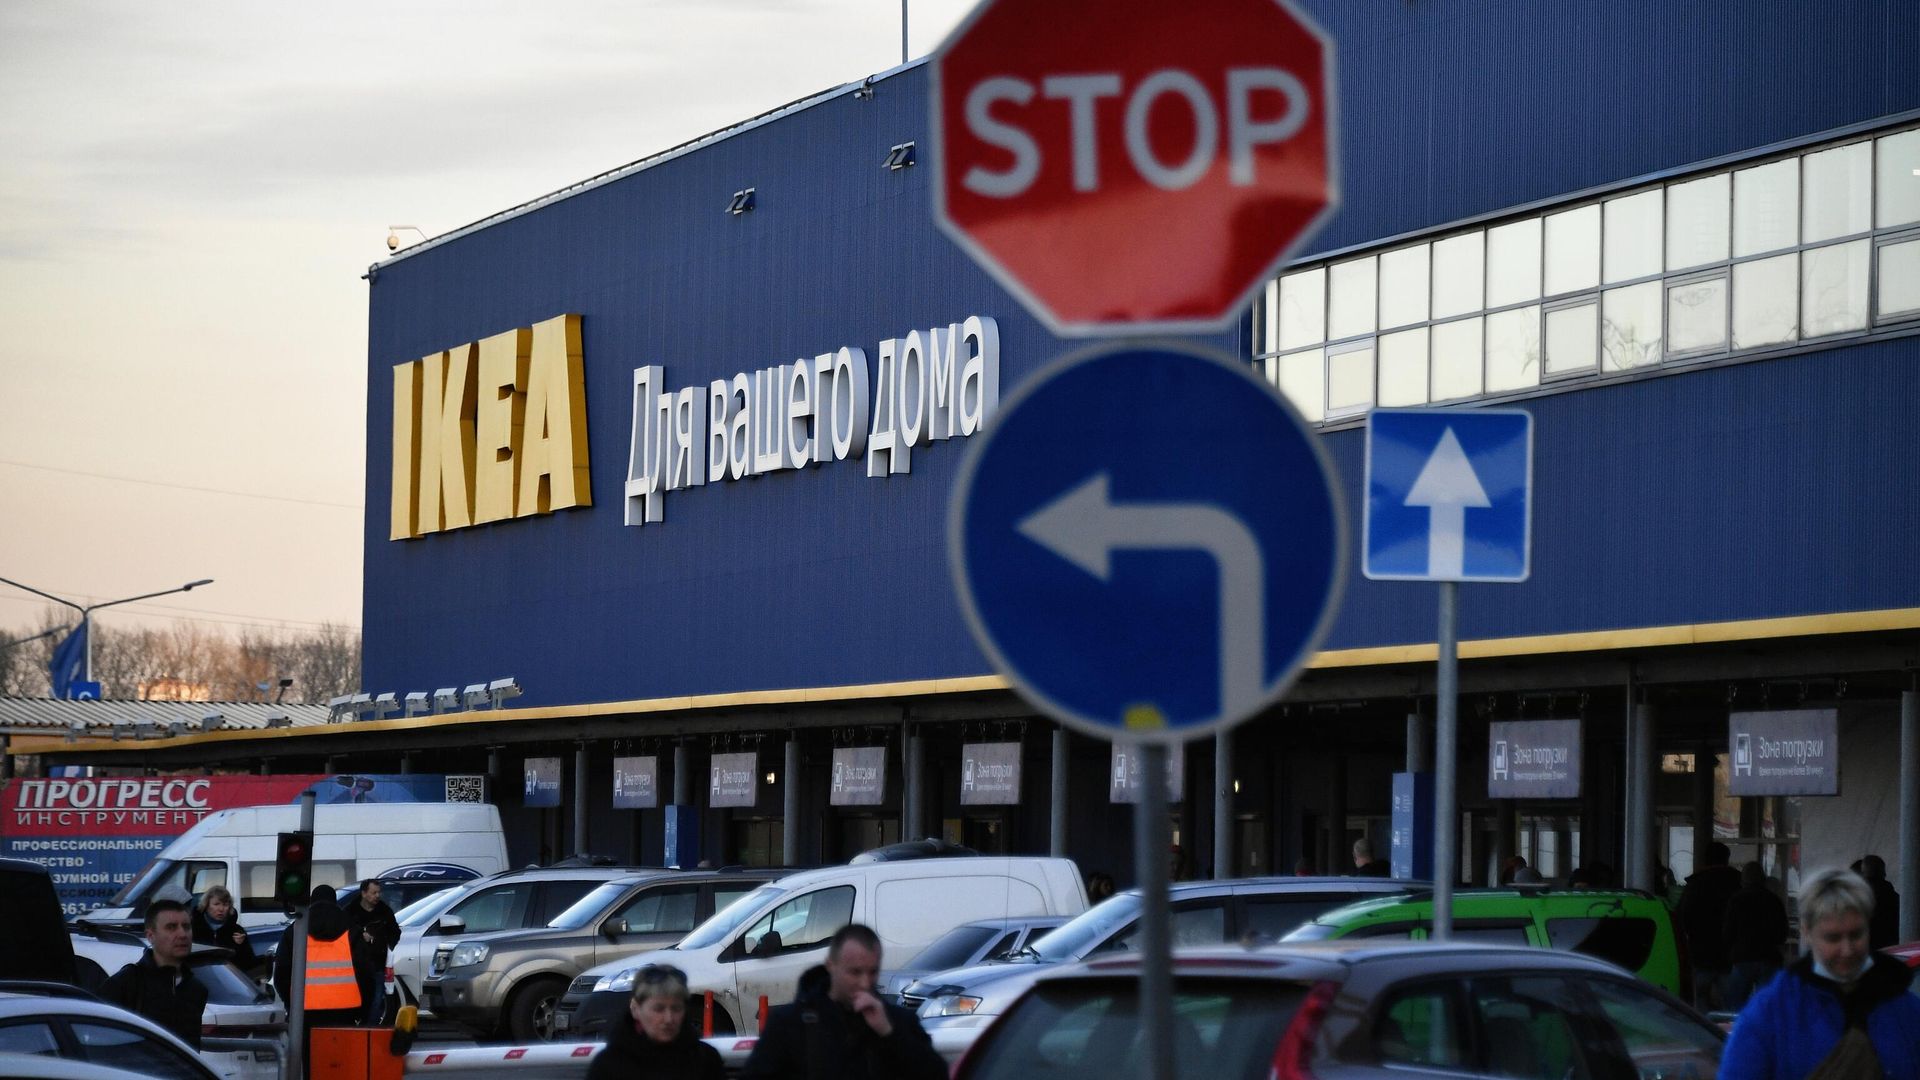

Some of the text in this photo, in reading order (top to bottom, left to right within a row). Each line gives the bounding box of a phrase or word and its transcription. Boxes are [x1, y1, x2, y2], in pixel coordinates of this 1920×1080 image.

[962, 65, 1310, 199] STOP
[389, 313, 592, 541] IKEA
[624, 315, 1000, 527] Для вашего дома
[1759, 736, 1824, 765] Зона погрузки
[18, 779, 211, 808] ПРОГРЕСС
[17, 812, 207, 825] ИНСТРУМЕНТ
[12, 840, 163, 851] ПРОФЕССИОНАЛЬНОЕ
[19, 857, 85, 867] ЕСТВО
